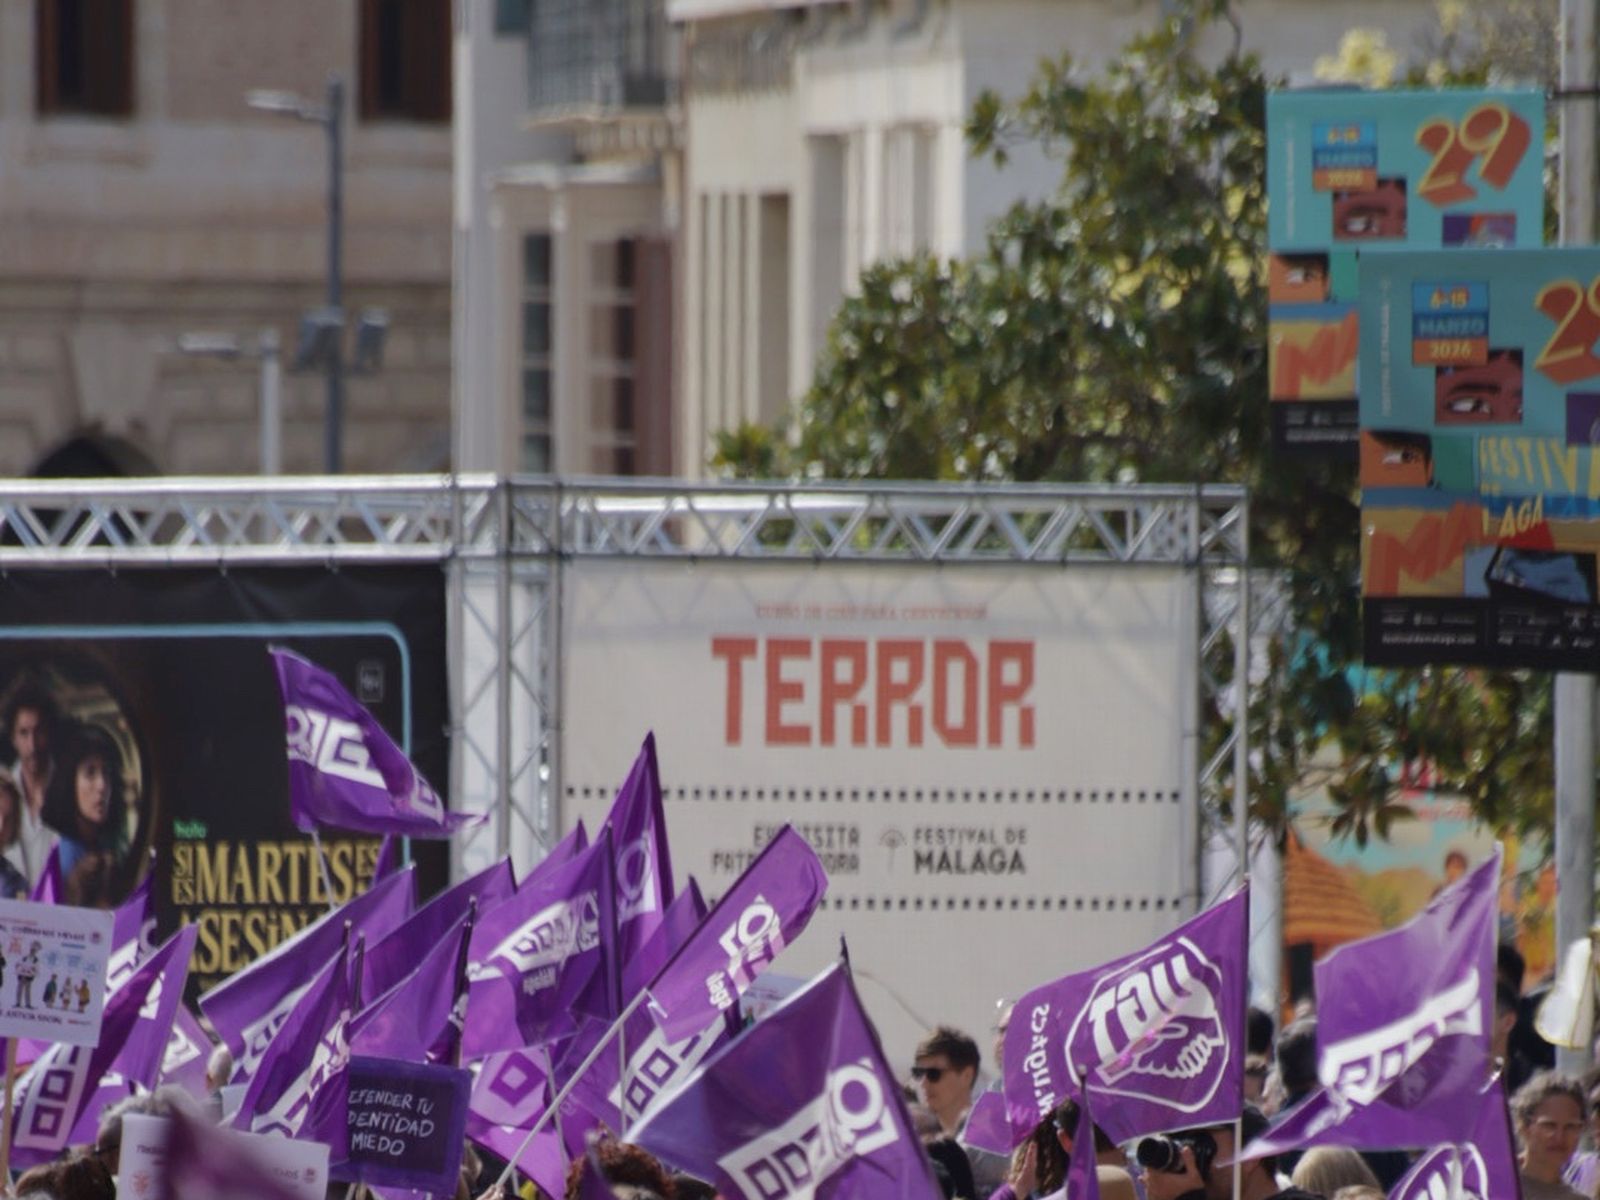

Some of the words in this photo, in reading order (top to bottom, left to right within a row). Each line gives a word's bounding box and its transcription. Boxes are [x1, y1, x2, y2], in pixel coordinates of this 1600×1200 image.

[1415, 101, 1530, 207] 29
[1533, 278, 1600, 384] 2
[711, 637, 1036, 748] TERROR
[195, 841, 353, 904] MARTES
[914, 827, 997, 845] FESTIVAL
[1004, 827, 1027, 845] DE
[348, 1089, 413, 1110] EFENDER
[415, 1098, 434, 1115] TU
